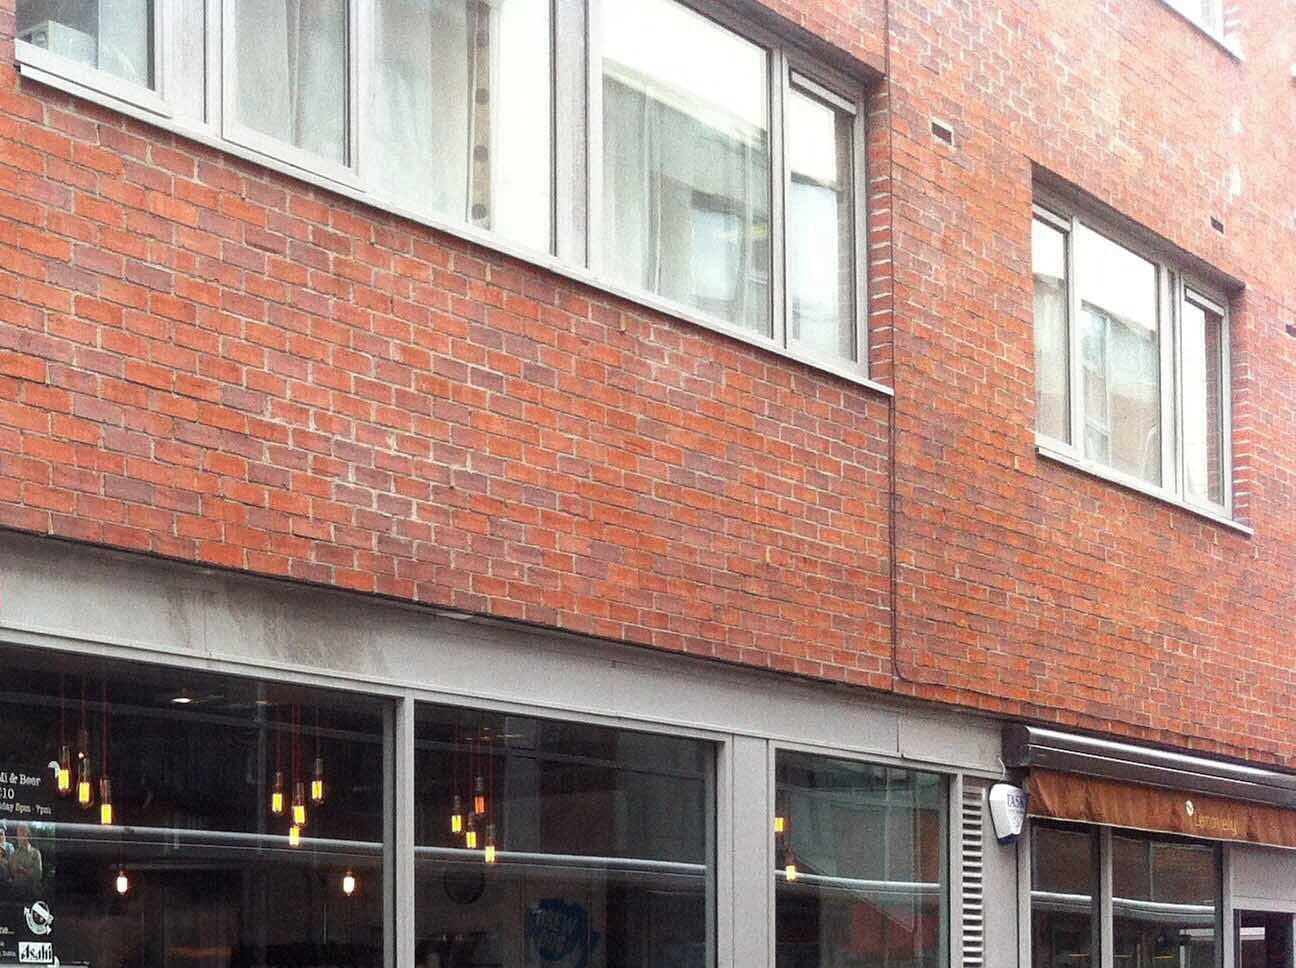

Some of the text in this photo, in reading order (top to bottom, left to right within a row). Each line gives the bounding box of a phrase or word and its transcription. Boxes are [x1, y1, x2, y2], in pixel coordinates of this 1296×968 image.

[9, 772, 18, 785] &
[19, 774, 41, 787] Beer
[20, 944, 52, 961] Asahi
